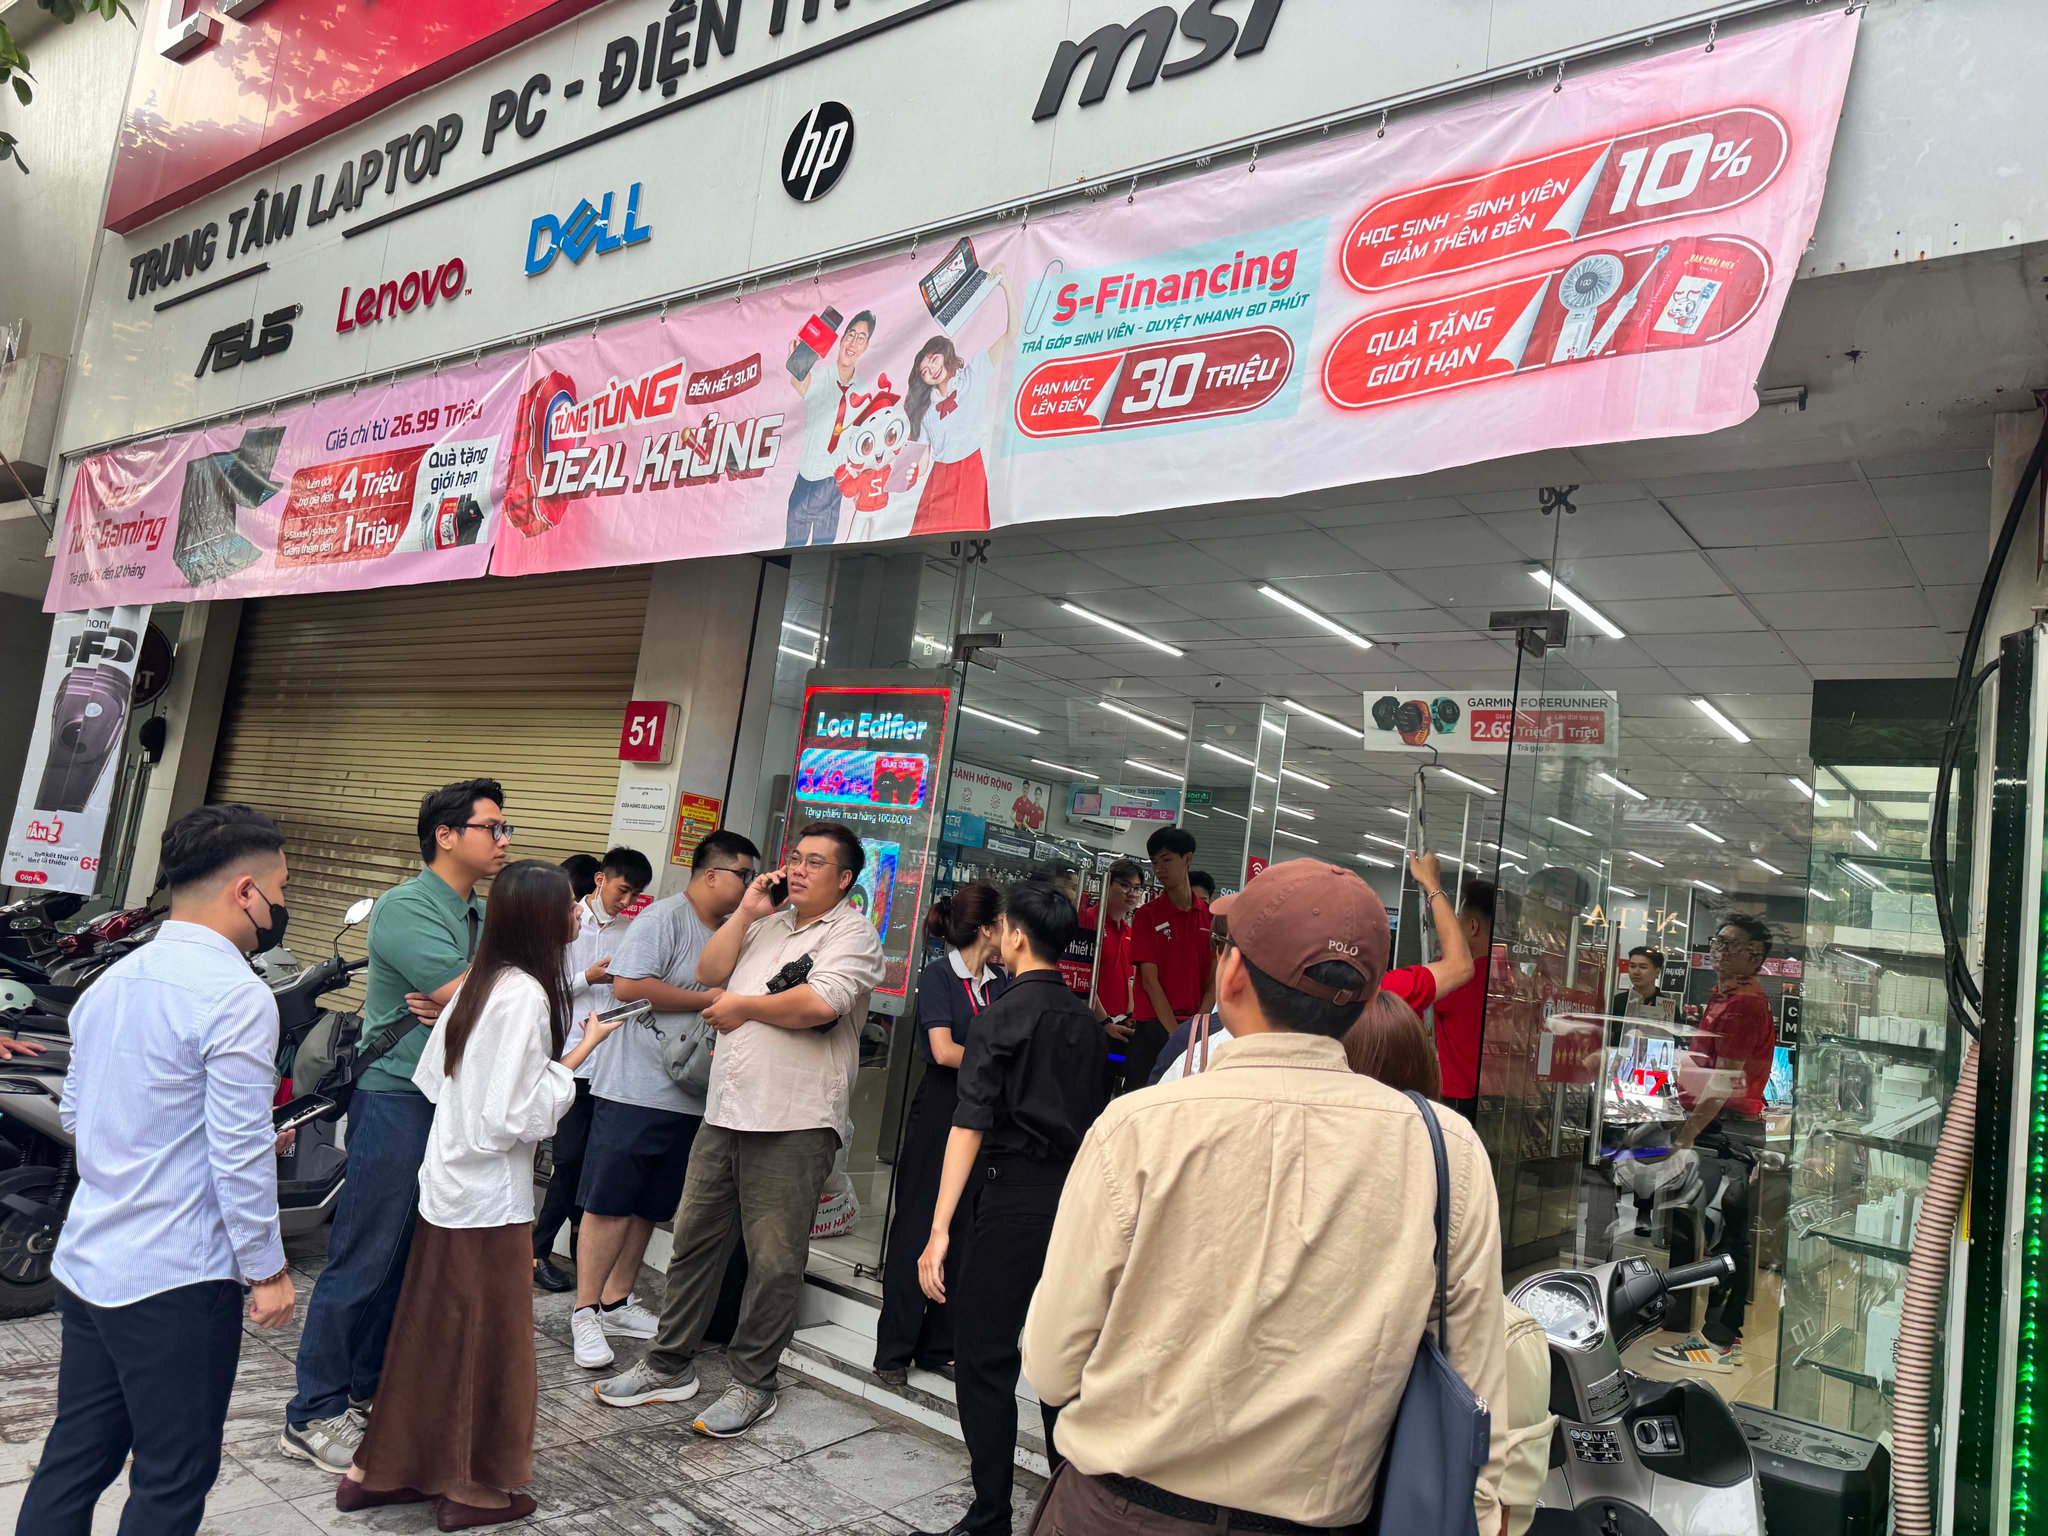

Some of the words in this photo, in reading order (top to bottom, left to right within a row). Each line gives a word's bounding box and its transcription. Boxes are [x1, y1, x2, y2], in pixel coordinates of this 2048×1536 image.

[128, 222, 219, 301] TRUNG
[226, 188, 302, 260] TÂM
[306, 113, 463, 227] LAPTOP
[481, 73, 551, 155] PC
[598, 0, 742, 108] ĐIỆN
[786, 102, 849, 201] hp
[525, 182, 652, 277] DELL
[1358, 223, 1396, 250] HỌC
[1399, 215, 1448, 240] SINH
[1465, 196, 1515, 223] SINH
[1519, 177, 1571, 211] VIÊN
[1381, 240, 1429, 268] GIẢM
[1432, 224, 1488, 253] THÊM
[1490, 206, 1536, 241] ĐẾN
[336, 257, 467, 334] Lenovo
[1052, 248, 1299, 325] S-Financing
[194, 304, 303, 378] ASUS
[1022, 333, 1045, 354] TRẢ
[1045, 333, 1072, 352] GÓP
[1073, 330, 1103, 347] SINH
[1106, 321, 1135, 341] VIÊN
[1146, 313, 1193, 333] DUYỆT
[1192, 307, 1243, 327] NHANH
[1269, 292, 1311, 314] PHÚT
[1366, 317, 1420, 356] QUÀ
[1428, 305, 1496, 343] TẶNG
[688, 378, 710, 398] ĐẾN
[711, 370, 732, 392] HẾT
[733, 361, 759, 387] 31.10
[1032, 382, 1059, 398] HẠN
[1062, 374, 1095, 392] MỨC
[1121, 352, 1207, 414] 30
[1205, 354, 1281, 390] TRIỆU
[1366, 349, 1422, 388] GIỚI
[1424, 342, 1482, 377] HẠN
[554, 404, 589, 437] TÙNG
[592, 360, 685, 431] TÙNG
[1031, 400, 1056, 417] LÊN
[1058, 390, 1088, 413] ĐẾN
[326, 427, 347, 451] Giá
[350, 420, 370, 446] chỉ
[372, 417, 390, 441] từ
[390, 408, 439, 438] 26.99
[444, 398, 483, 428] Triệu
[429, 448, 457, 469] Quà
[460, 446, 489, 466] tặng
[537, 446, 629, 498] DEAL
[635, 412, 786, 492] KHỦNG
[338, 467, 359, 504] 4
[361, 467, 404, 499] Triệu
[430, 472, 456, 495] giới
[456, 470, 478, 487] hạn
[96, 510, 167, 552] Gaming
[343, 515, 354, 553] 1
[355, 517, 400, 549] Triệu
[122, 561, 147, 579] tháng
[1467, 697, 1514, 708] GARMIN
[1520, 697, 1608, 708] FORERUNNER
[628, 715, 659, 747] 51
[816, 711, 854, 738] Loa
[857, 712, 928, 741] Edifier
[1518, 726, 1548, 739] Triệu
[802, 768, 844, 796] 3.49
[1328, 939, 1359, 956] POLO
[1633, 1069, 1669, 1097] 17
